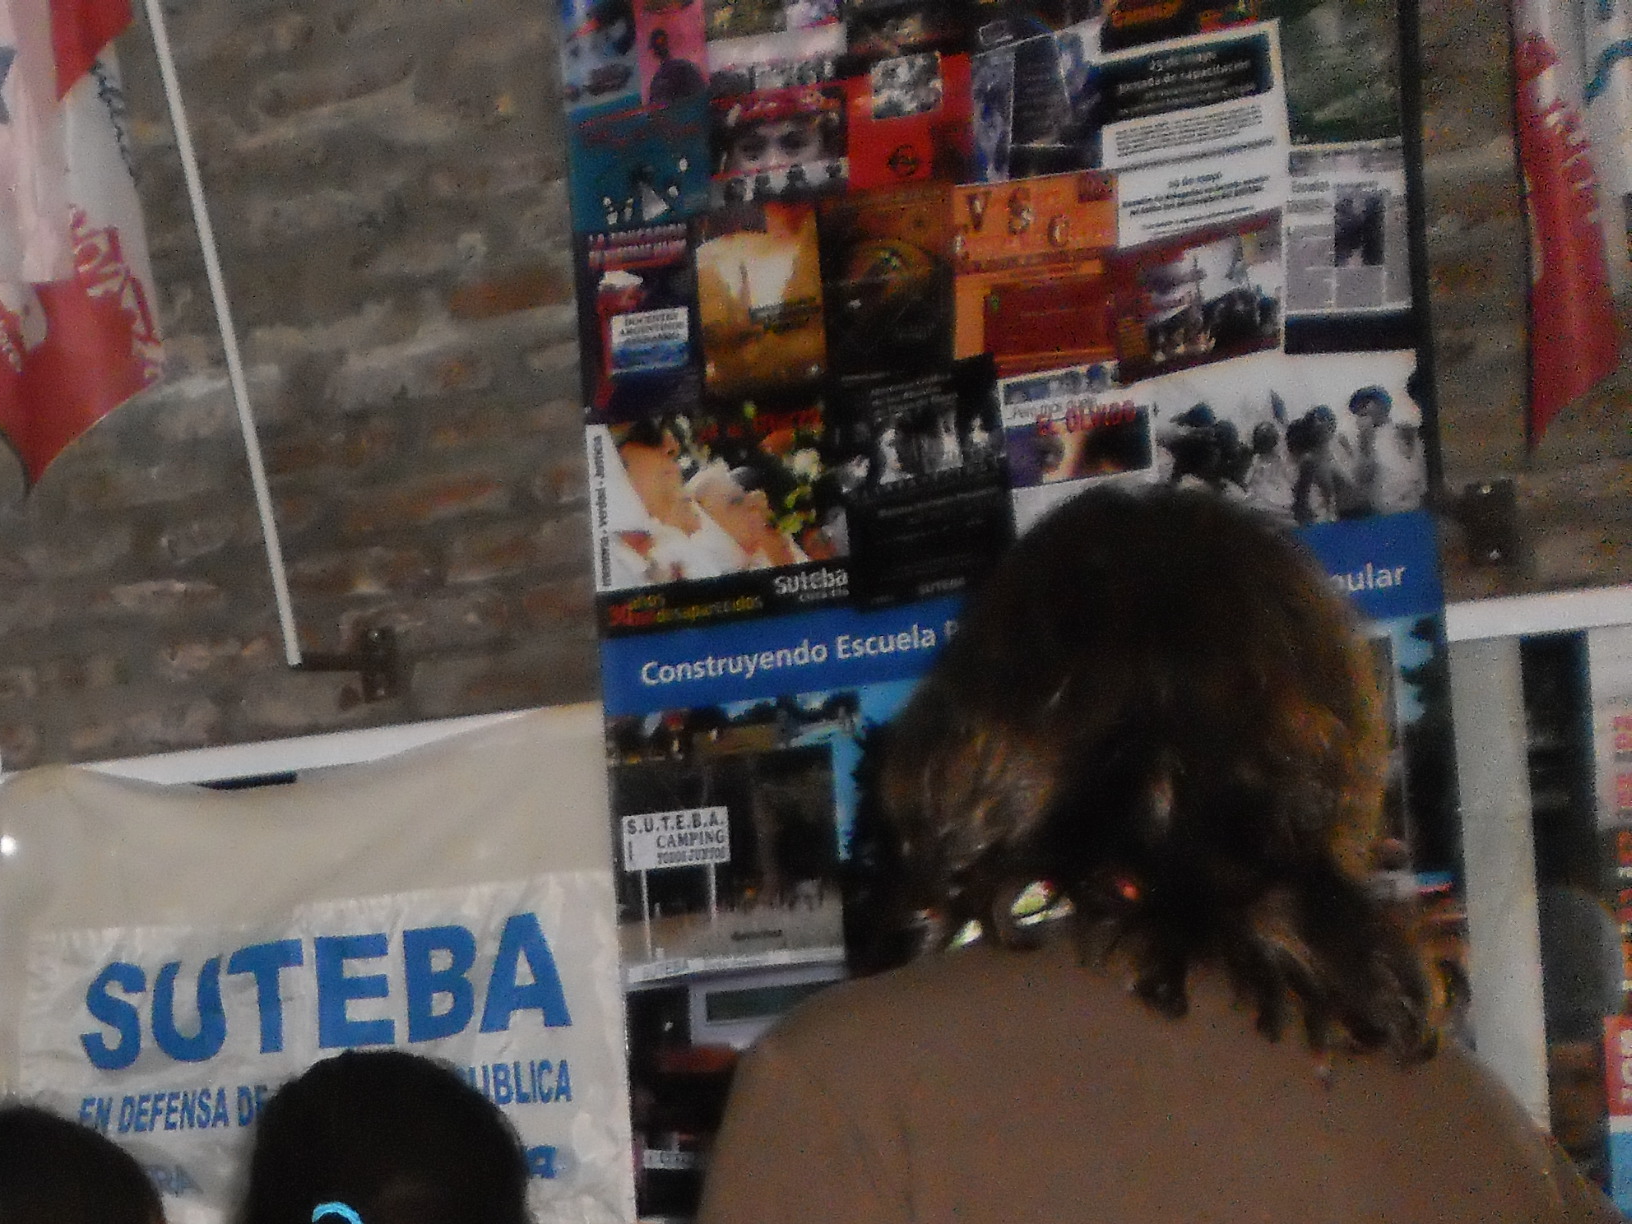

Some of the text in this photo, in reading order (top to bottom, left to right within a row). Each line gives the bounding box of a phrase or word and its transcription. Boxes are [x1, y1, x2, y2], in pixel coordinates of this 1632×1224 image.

[640, 638, 829, 687] Construyendo
[836, 622, 937, 660] Escuela
[627, 810, 724, 835] S.U.T.E.B.A.
[656, 828, 725, 849] CAMPING
[80, 911, 574, 1071] SUTEBA
[118, 1086, 230, 1133] DEFENSA
